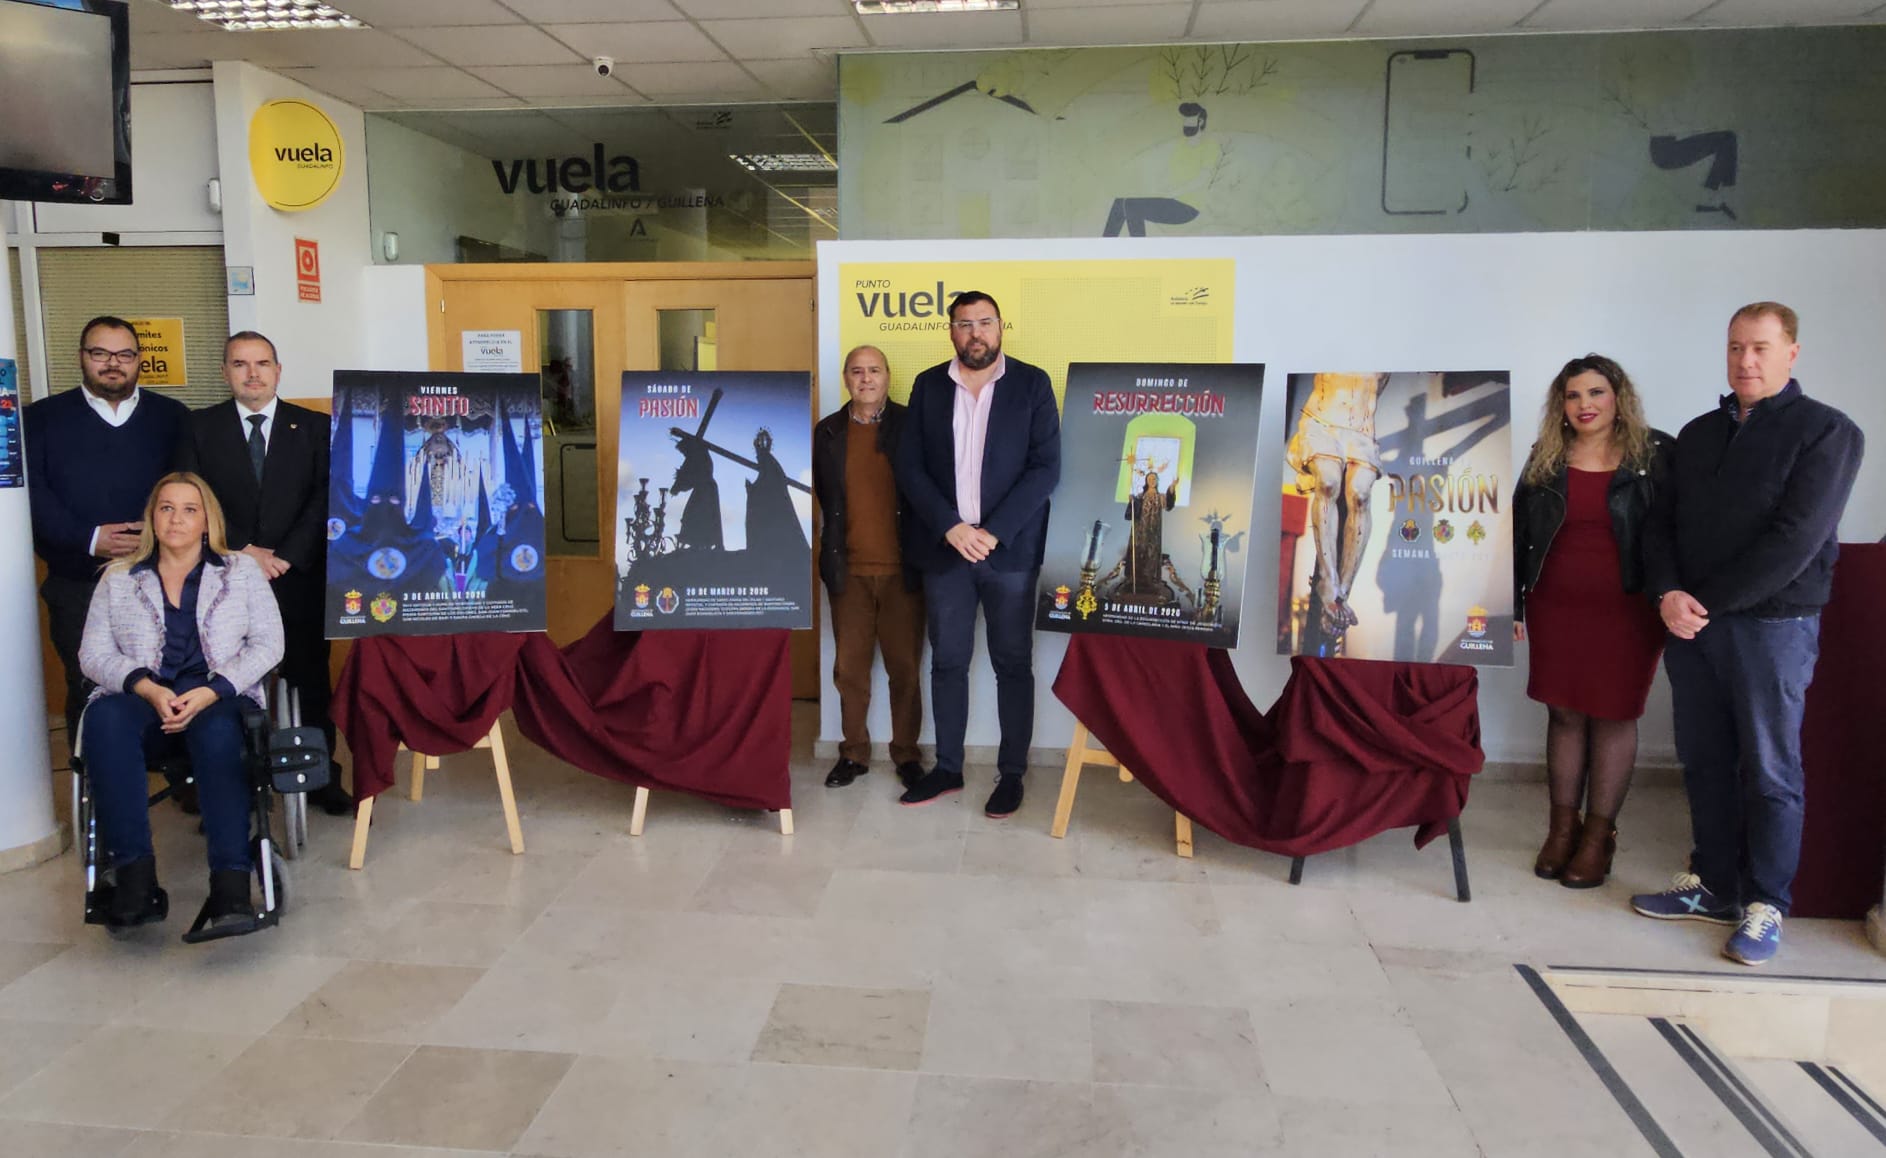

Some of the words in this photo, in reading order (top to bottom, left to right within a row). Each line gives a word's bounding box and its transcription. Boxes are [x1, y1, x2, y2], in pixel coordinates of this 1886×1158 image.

[274, 142, 333, 162] vuela
[491, 142, 640, 194] vuela
[550, 199, 641, 211] GUADALINFO
[657, 196, 725, 209] GUILLENA
[855, 279, 891, 289] PUNTO
[879, 322, 951, 332] GUADALINFO
[140, 355, 167, 373] ela
[681, 385, 692, 394] DE
[1135, 378, 1175, 388] DOMINGO
[1177, 378, 1189, 388] DE
[420, 386, 458, 395] VIERNES
[409, 395, 470, 417] SANTO
[639, 395, 700, 419] PASIÓN
[1093, 389, 1226, 417] RESURRECCIÓN
[1388, 467, 1500, 514] PASIÓN
[1392, 548, 1431, 559] SEMANA
[403, 592, 409, 601] 3
[411, 592, 422, 601] DE
[424, 592, 449, 601] ABRIL
[451, 591, 462, 600] DE
[698, 587, 708, 596] DE
[709, 587, 735, 596] MARZO
[737, 587, 747, 596] DE
[1111, 603, 1121, 613] DE
[1123, 604, 1146, 614] ABRIL
[1148, 606, 1158, 616] DE
